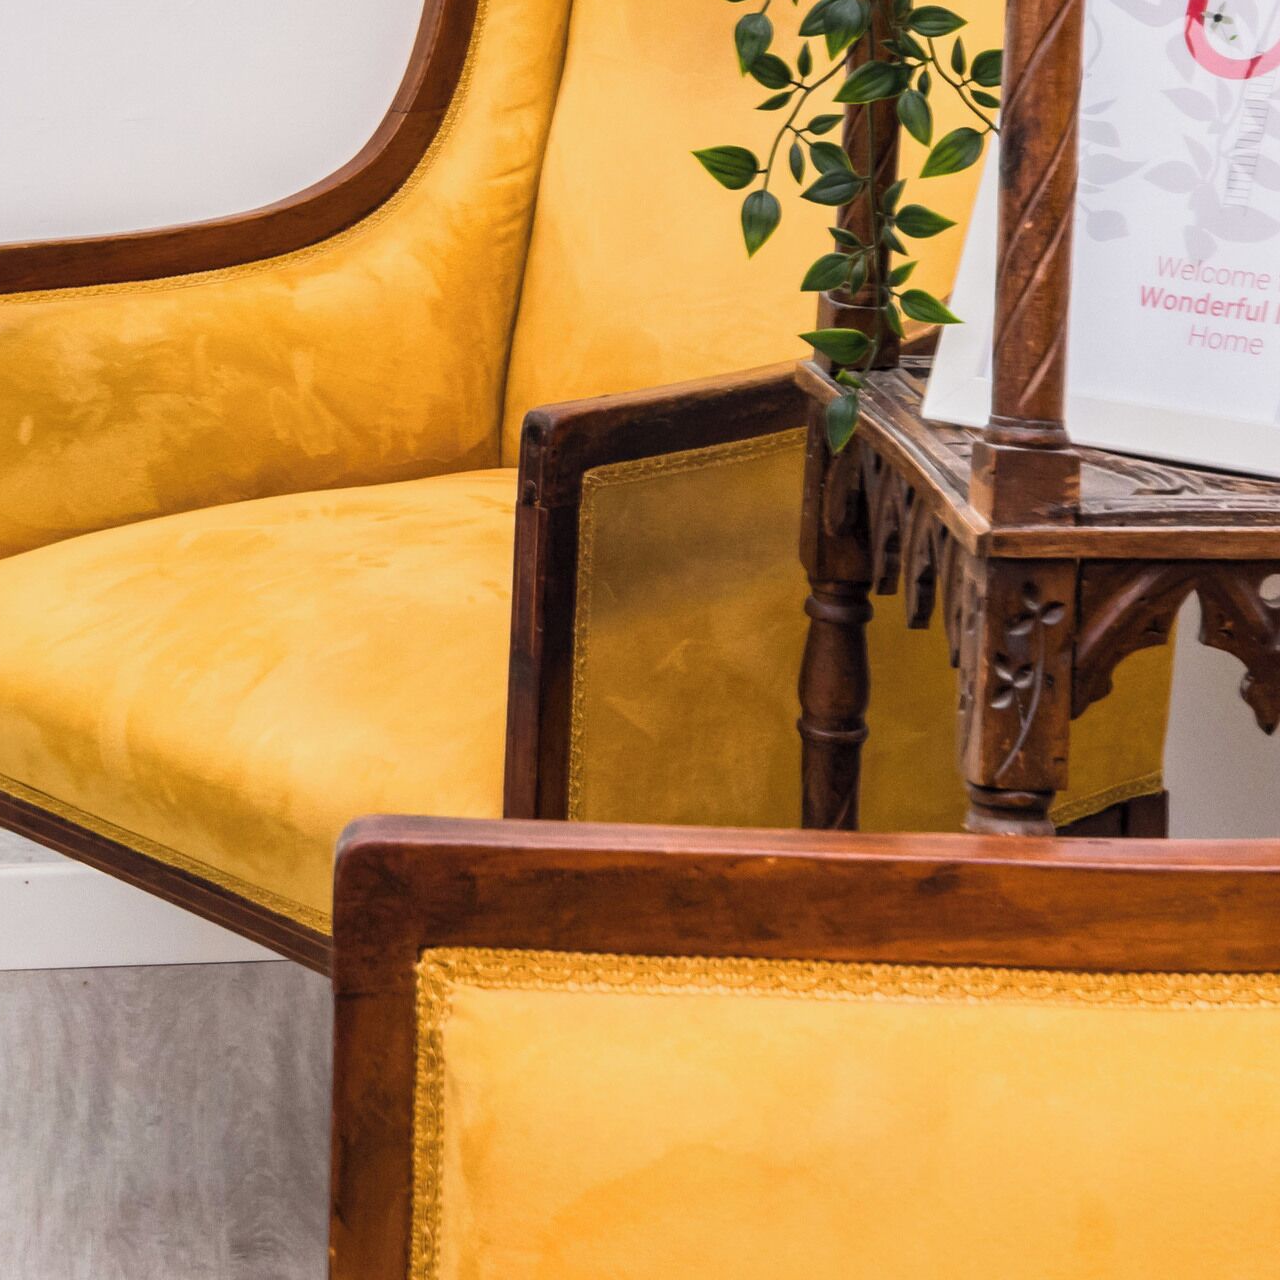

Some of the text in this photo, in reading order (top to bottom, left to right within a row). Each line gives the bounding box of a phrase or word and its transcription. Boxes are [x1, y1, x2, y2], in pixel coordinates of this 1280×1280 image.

[1157, 256, 1271, 290] Welcome
[1141, 286, 1269, 322] Wonderful
[1188, 325, 1264, 355] Home
